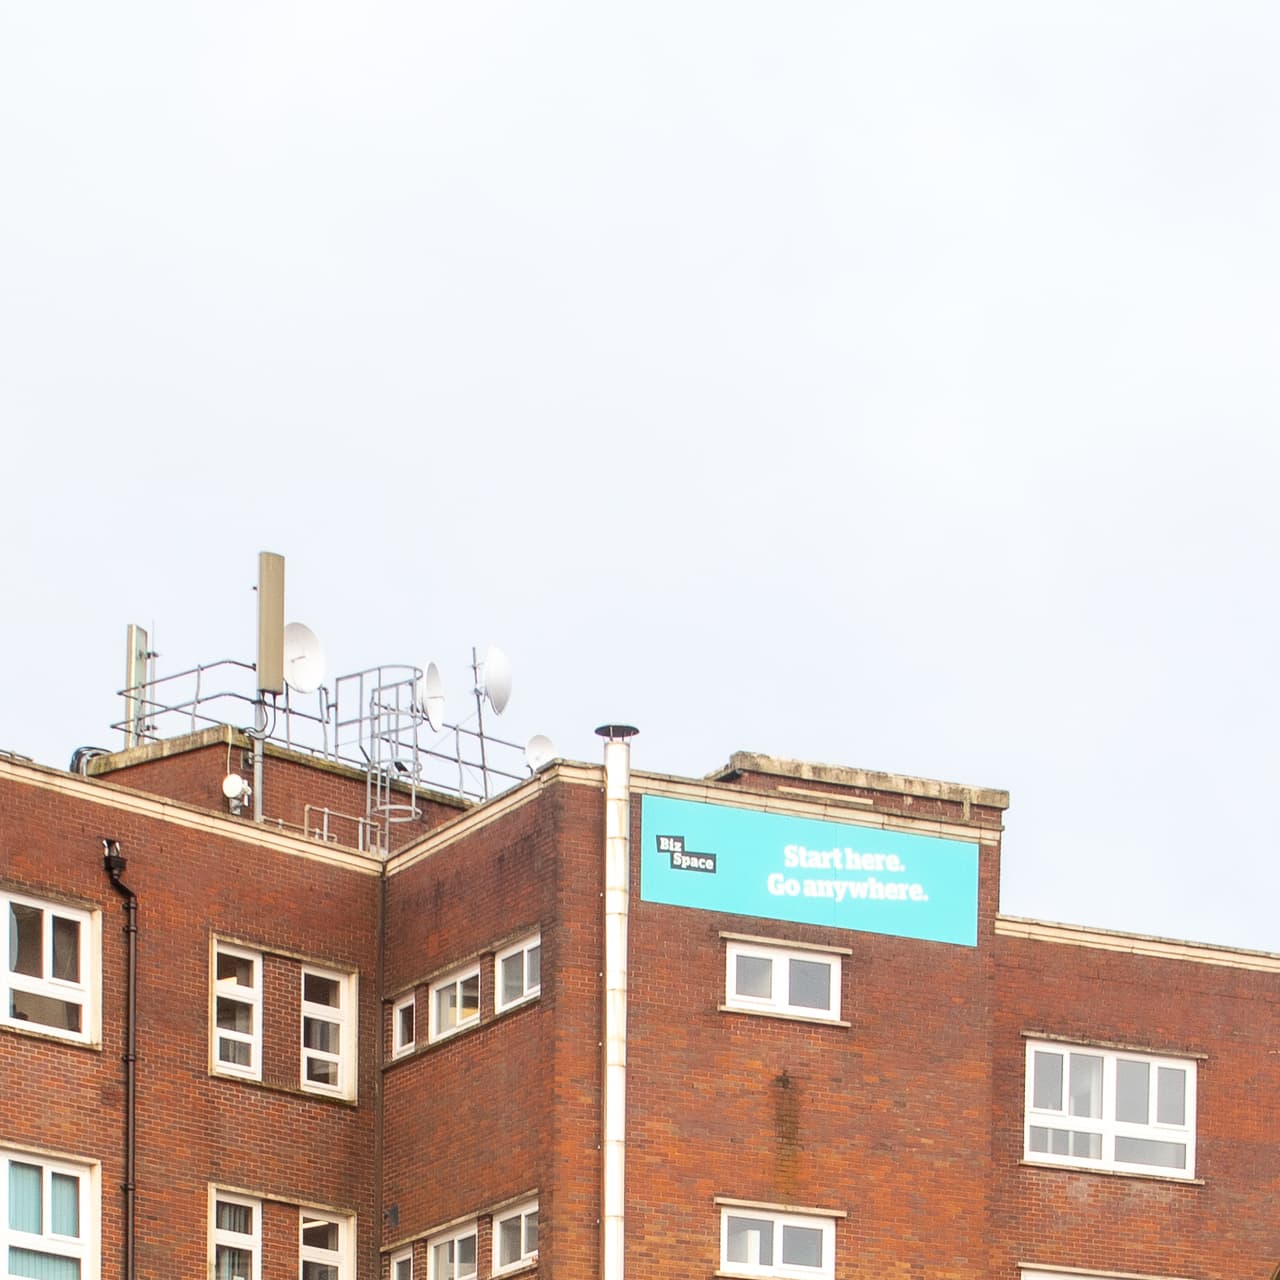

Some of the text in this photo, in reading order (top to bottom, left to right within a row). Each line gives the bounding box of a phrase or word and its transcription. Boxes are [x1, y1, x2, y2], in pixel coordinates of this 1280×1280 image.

[659, 836, 683, 852] Biz
[673, 853, 714, 871] Space
[784, 845, 905, 872] Start here.
[767, 874, 929, 903] Go anywhere.
